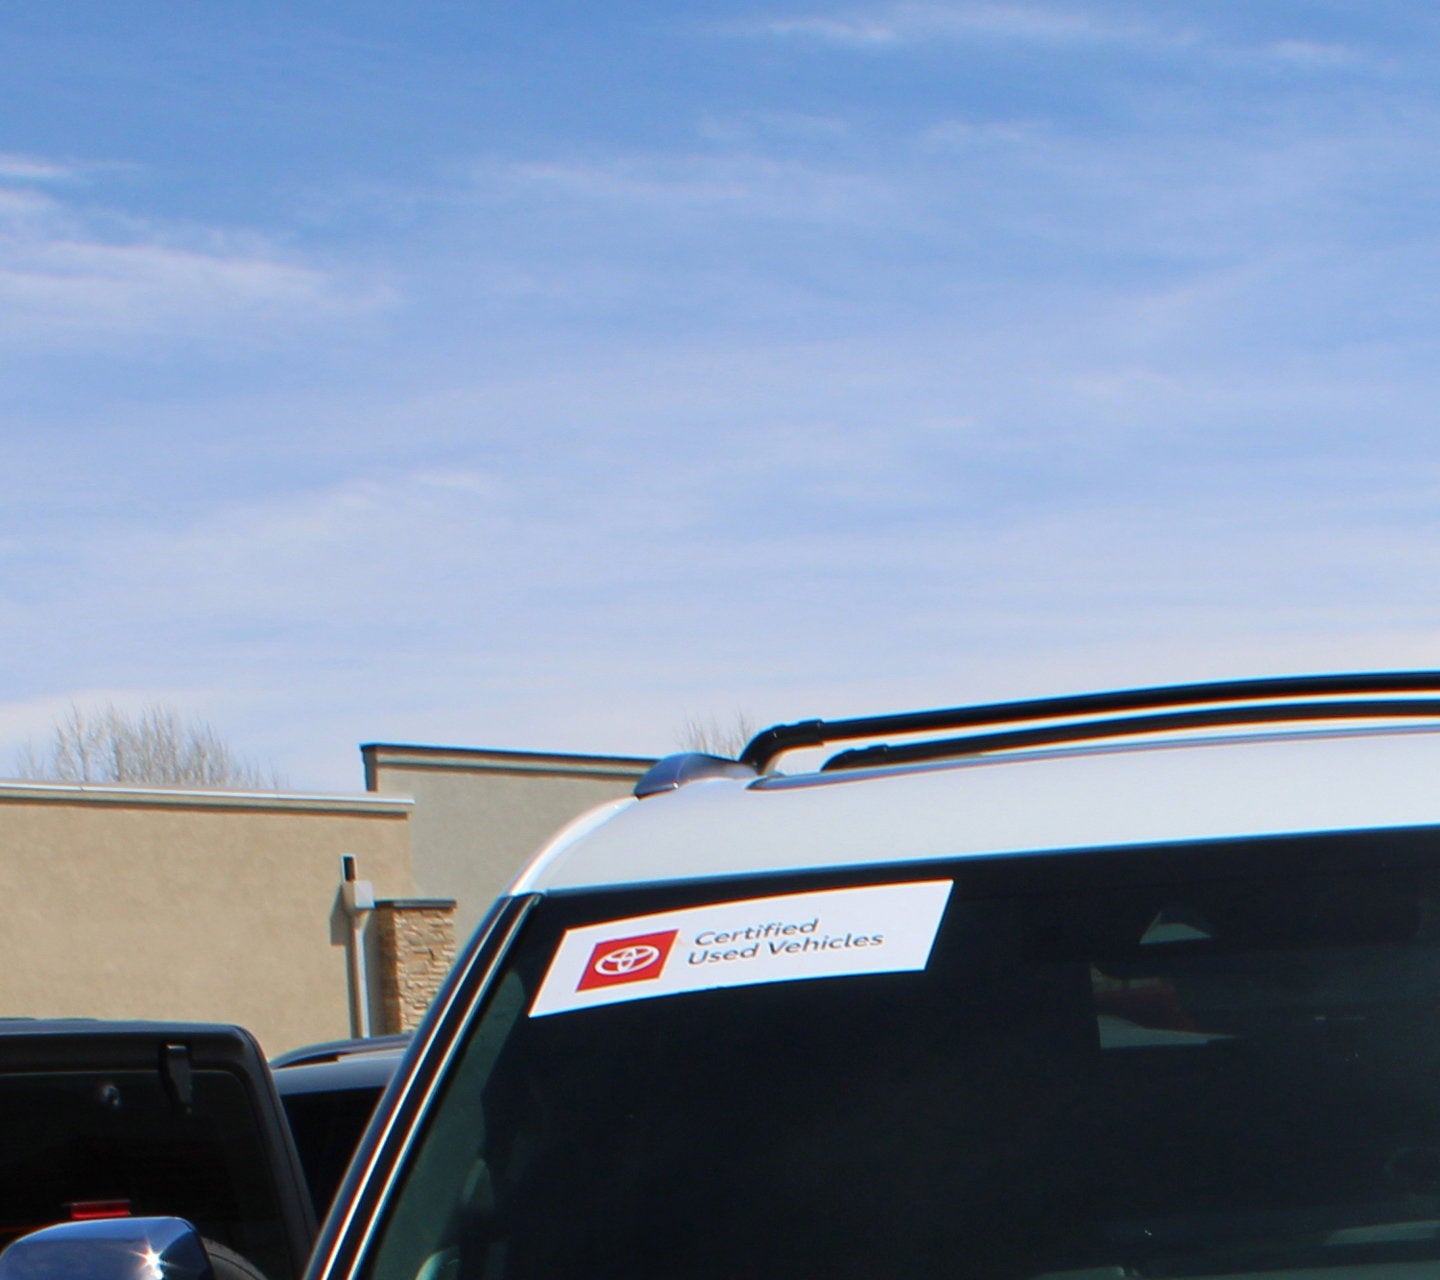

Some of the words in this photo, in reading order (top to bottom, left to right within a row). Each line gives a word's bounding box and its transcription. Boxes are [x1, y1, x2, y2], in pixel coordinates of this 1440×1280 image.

[695, 918, 819, 946] Certified
[688, 943, 760, 965] Used
[768, 933, 884, 956] Vehicles
